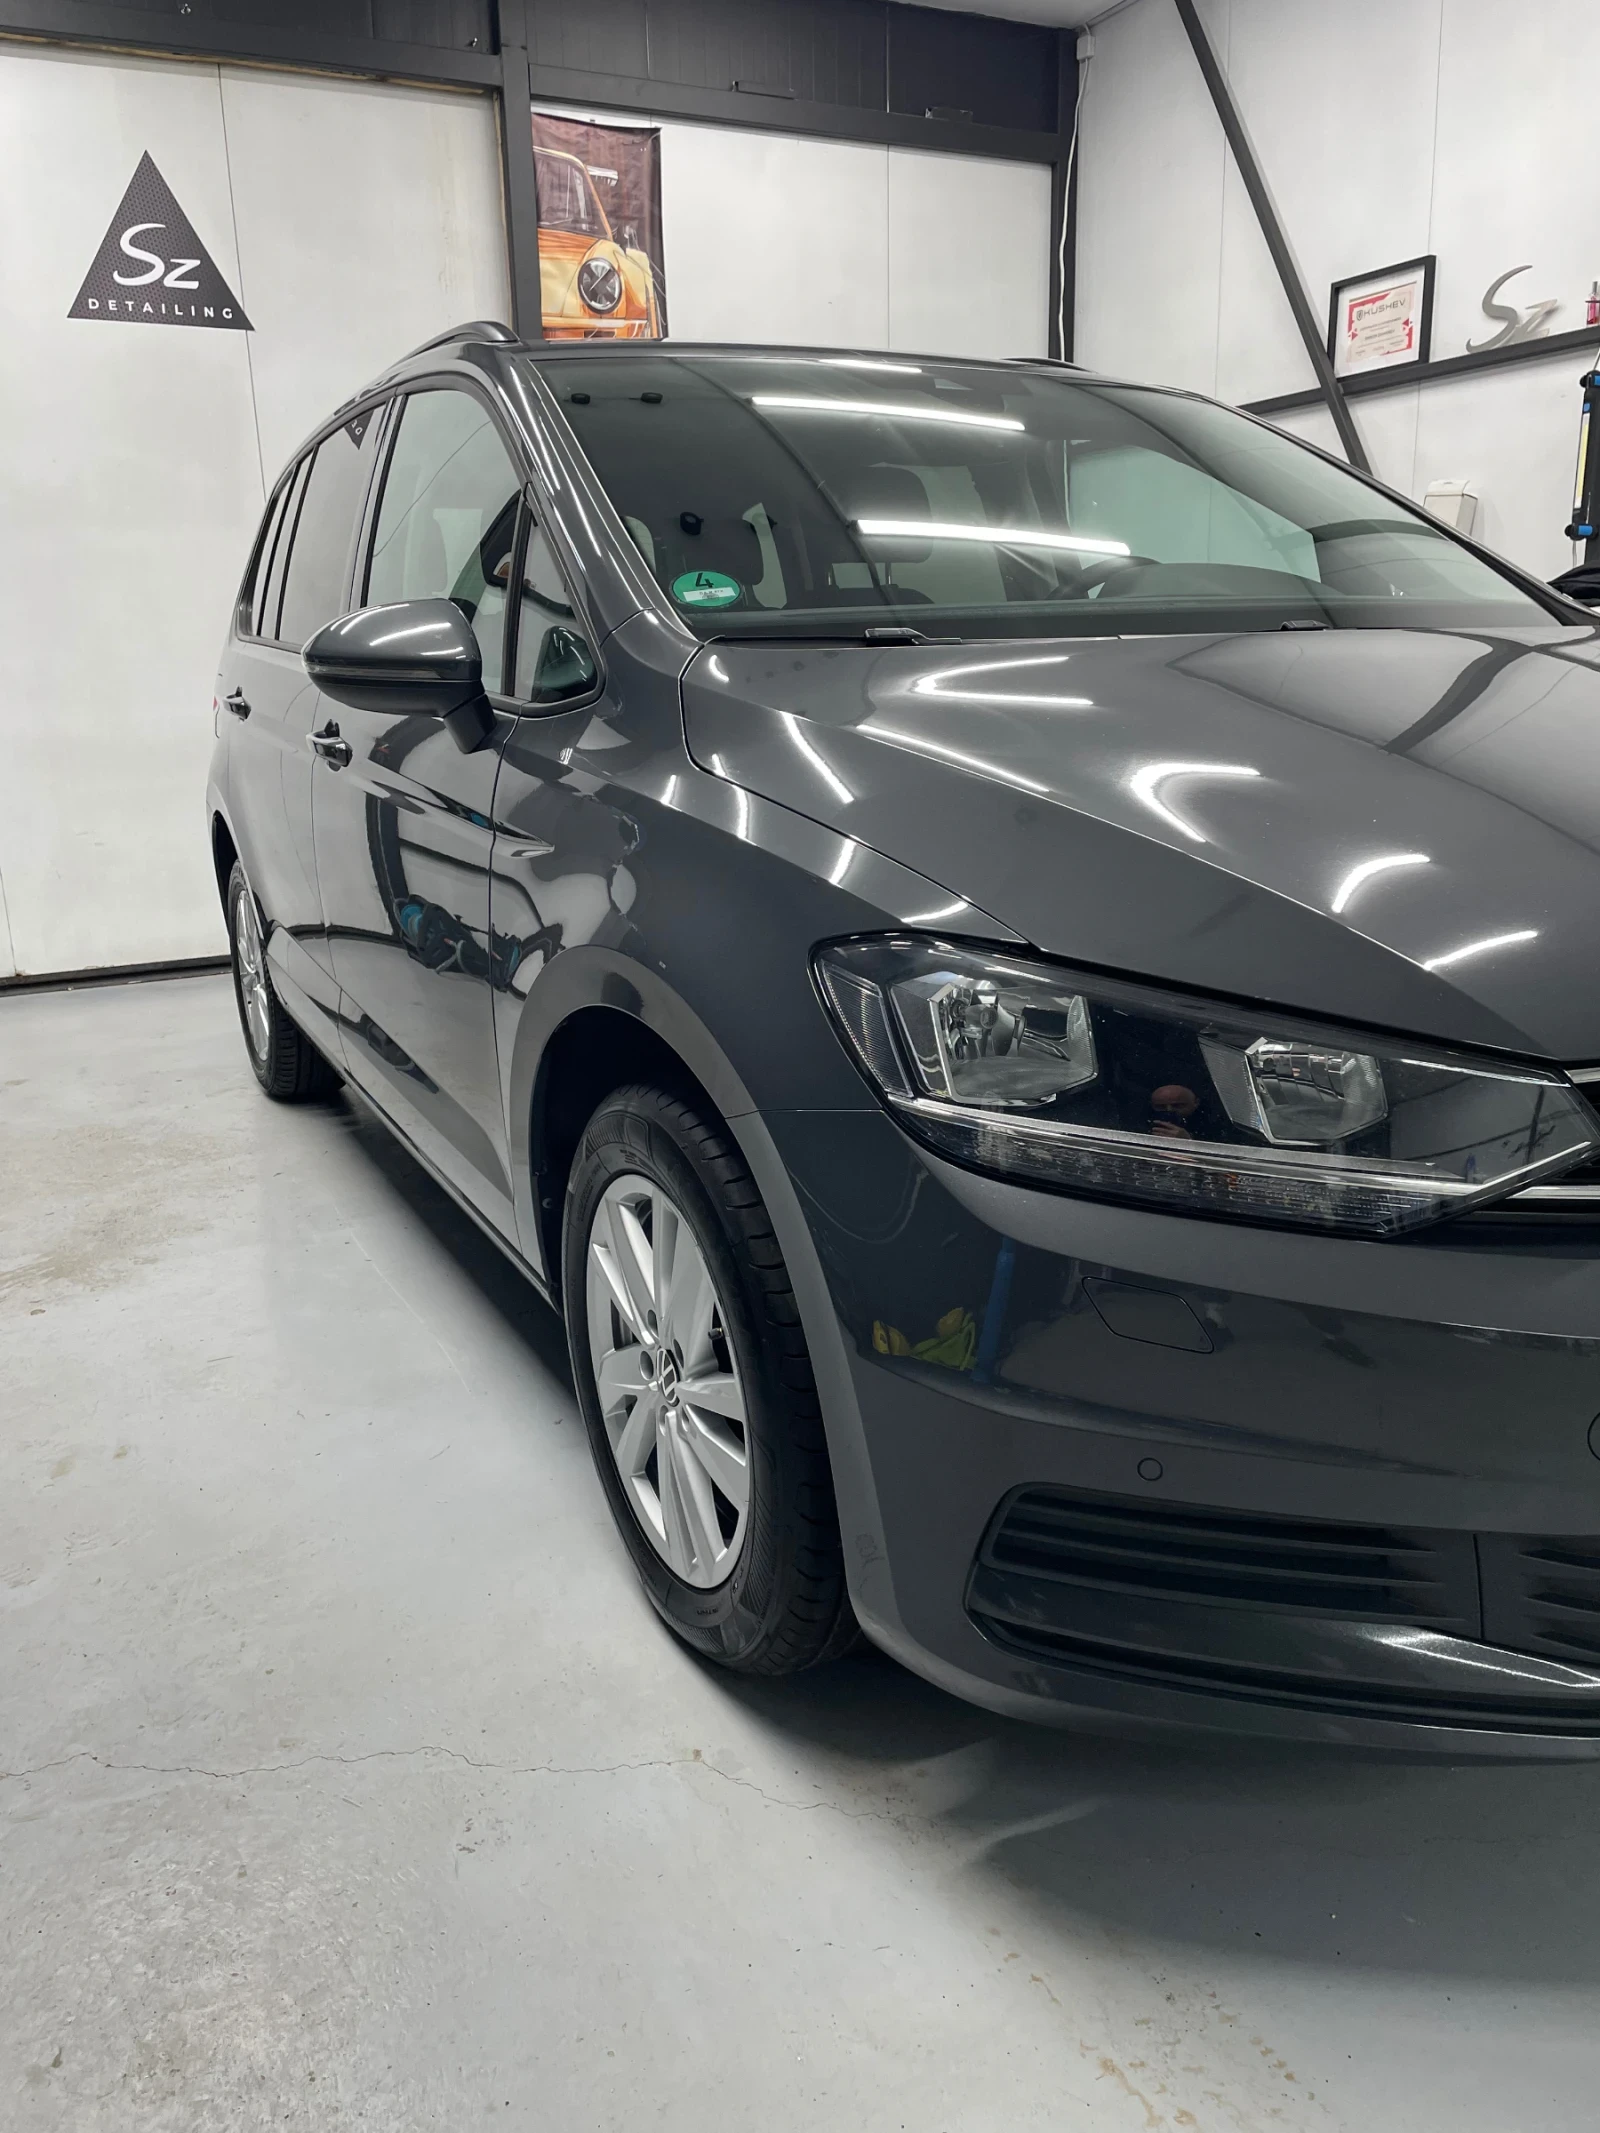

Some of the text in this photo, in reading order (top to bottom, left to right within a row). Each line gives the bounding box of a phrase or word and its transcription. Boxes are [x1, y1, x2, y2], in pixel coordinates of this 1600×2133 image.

[113, 223, 200, 289] Sz
[88, 298, 233, 319] DETAILING
[695, 572, 714, 588] 4
